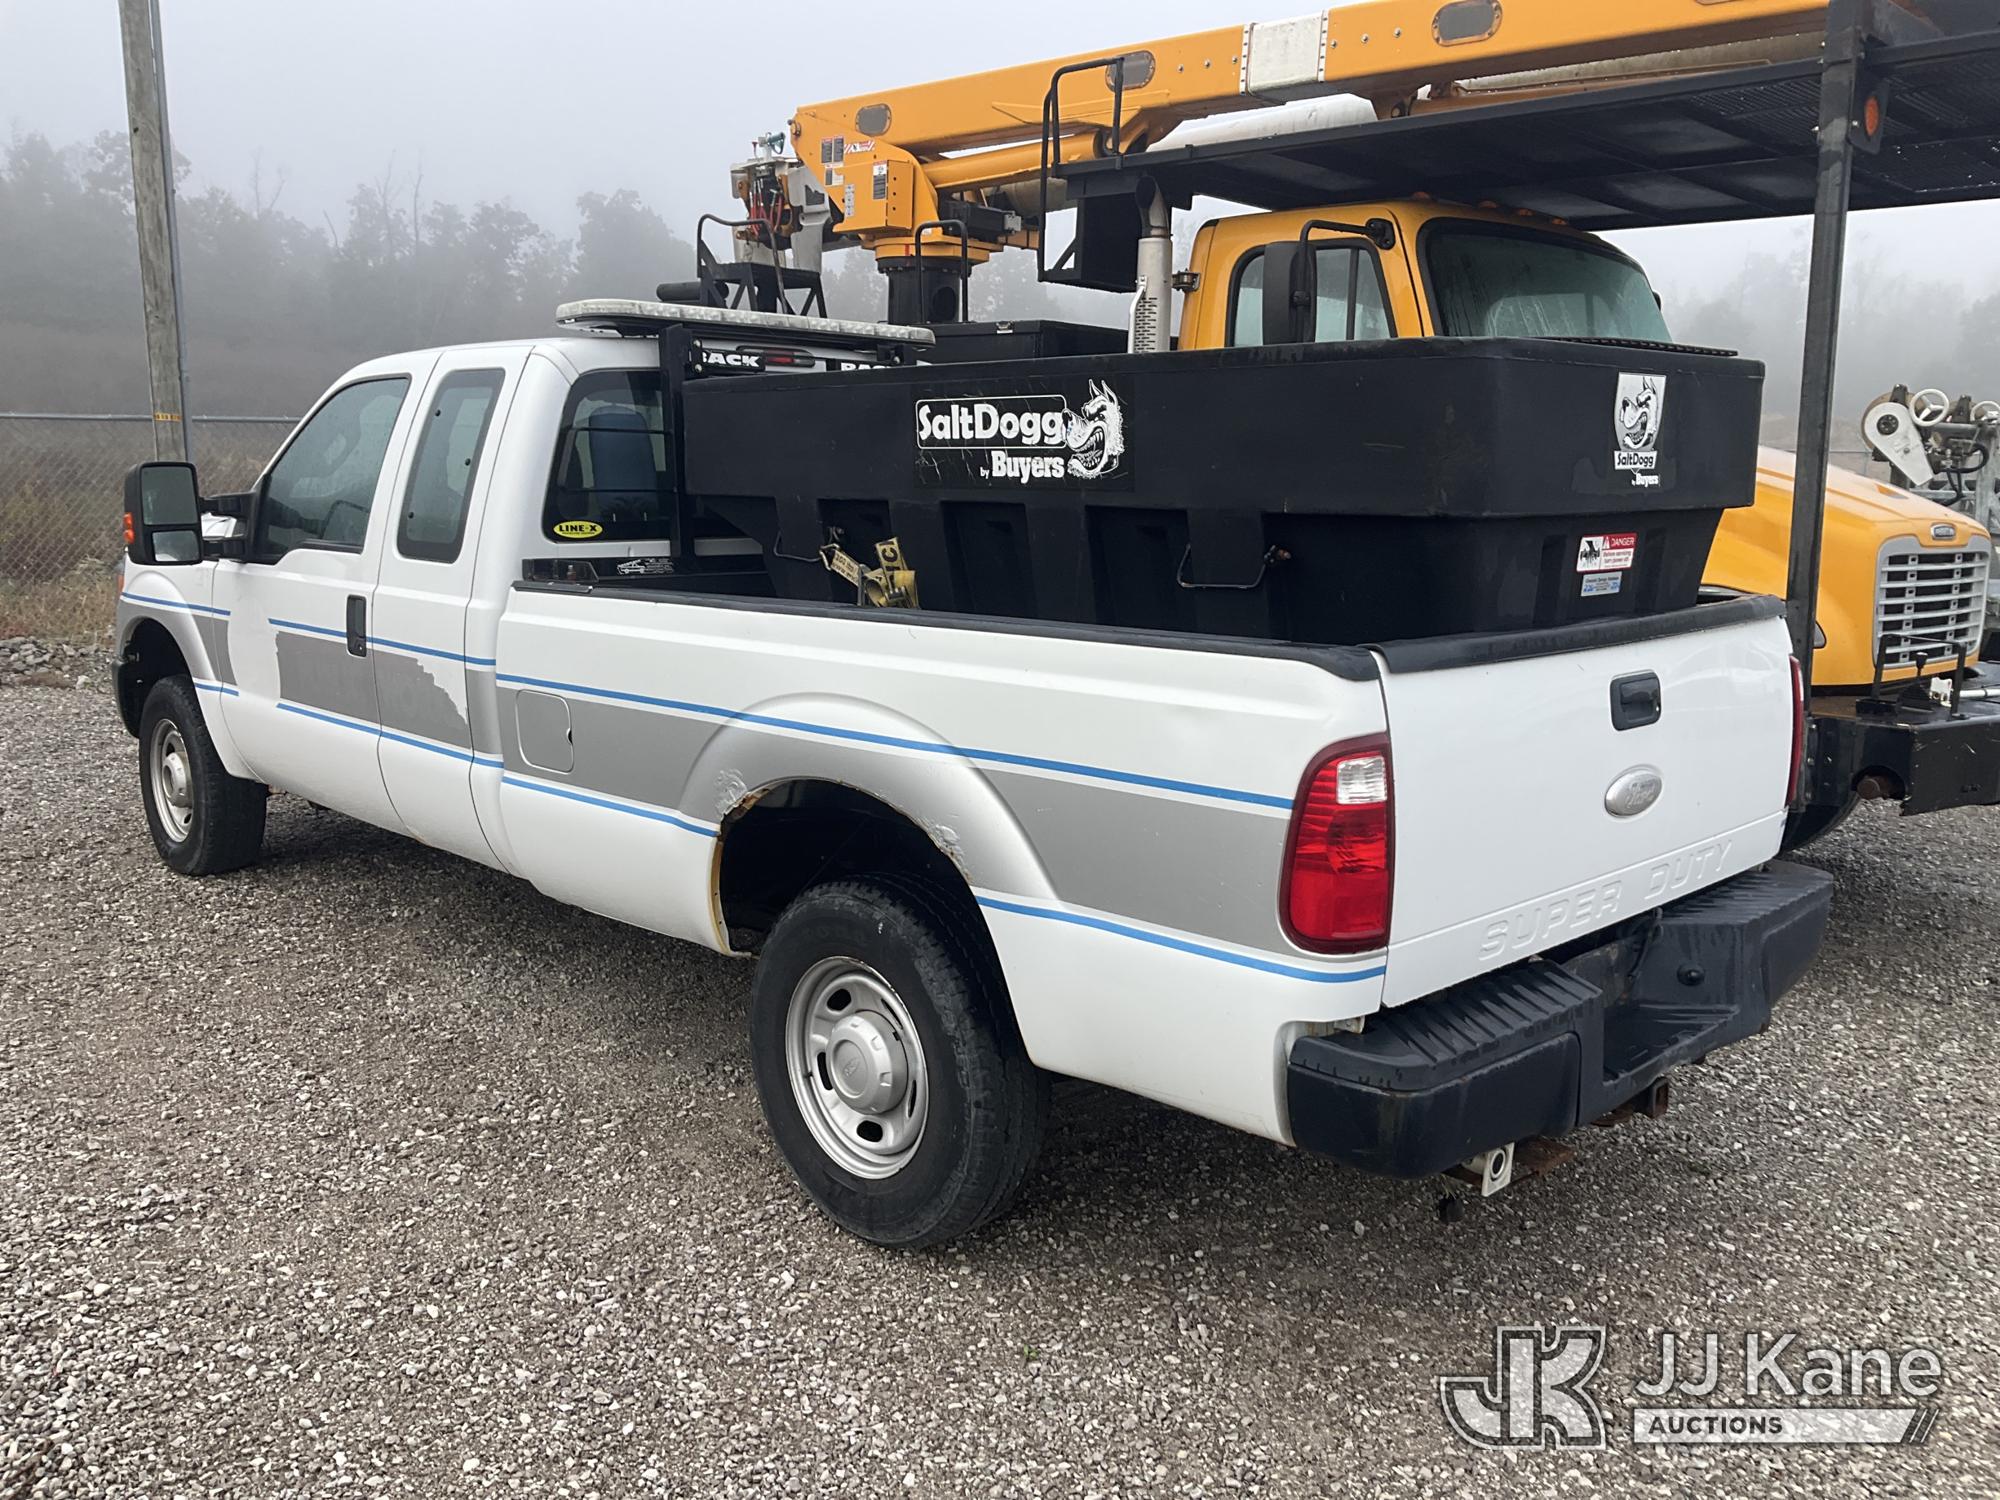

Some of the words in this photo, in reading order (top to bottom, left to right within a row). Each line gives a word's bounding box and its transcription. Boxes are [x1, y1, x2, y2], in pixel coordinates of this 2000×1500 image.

[918, 403, 1065, 446] SaltDogg
[980, 466, 990, 479] by
[991, 450, 1065, 484] Buyers
[1617, 452, 1654, 468] SaltDogg
[1636, 473, 1659, 488] Buyers
[1611, 537, 1635, 546] DANGER
[1479, 878, 1624, 961] SUPER
[1644, 839, 1732, 901] DUTY
